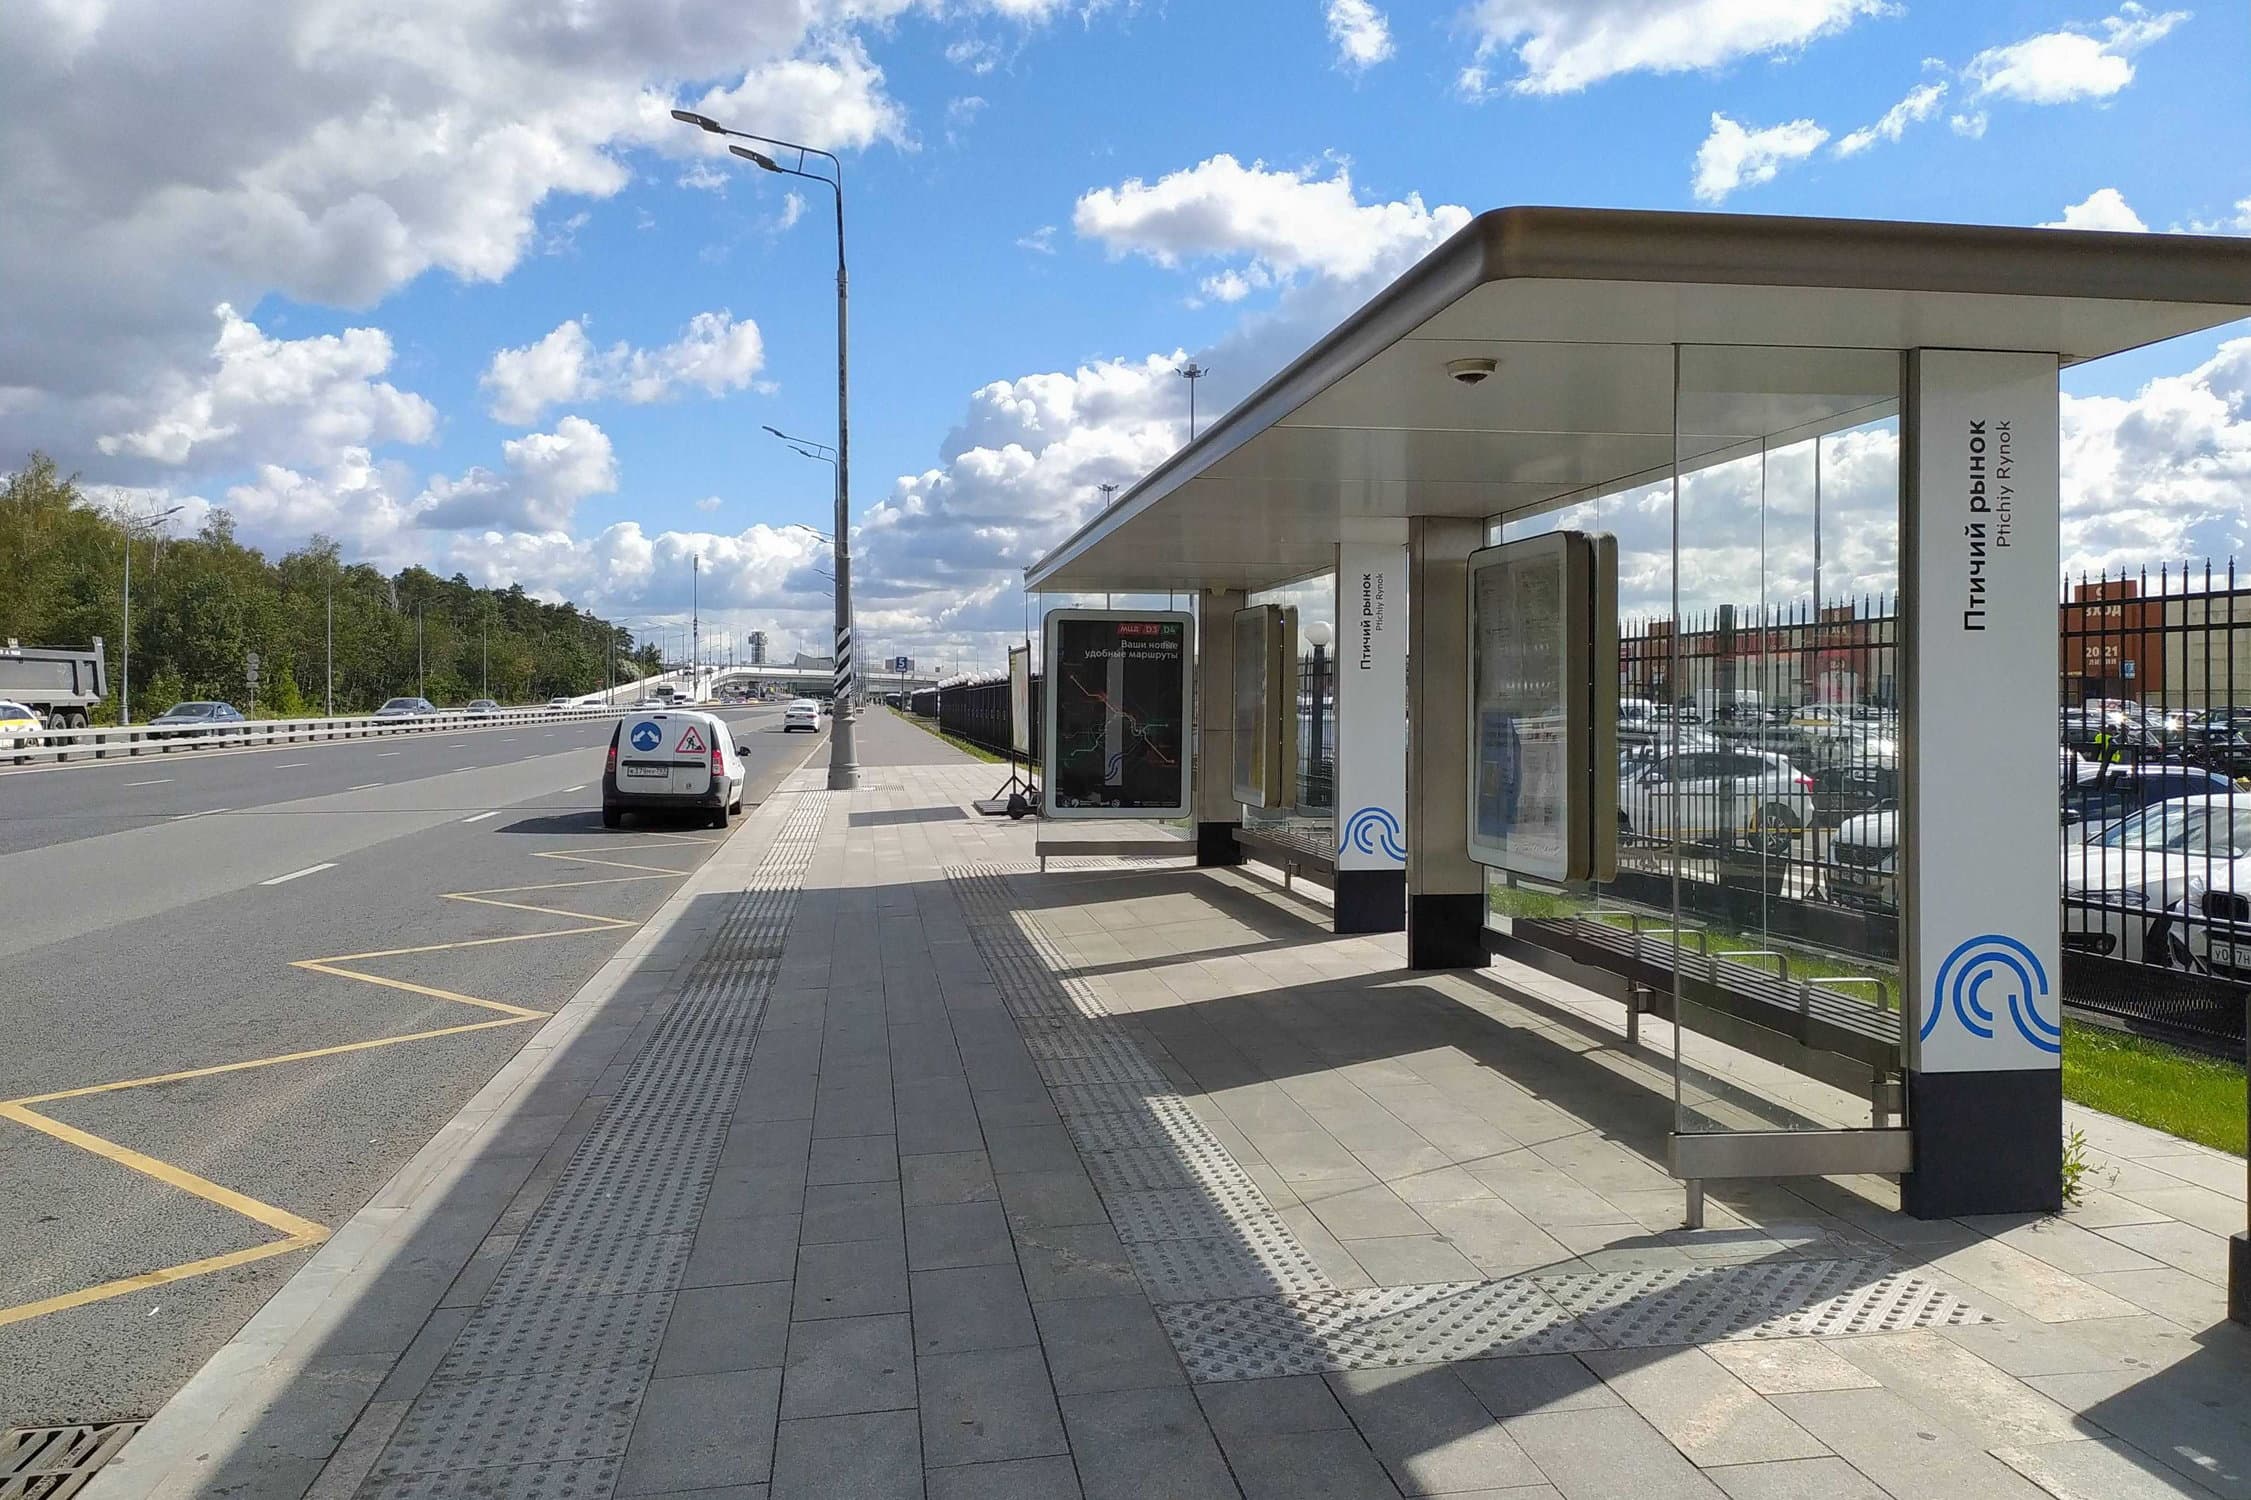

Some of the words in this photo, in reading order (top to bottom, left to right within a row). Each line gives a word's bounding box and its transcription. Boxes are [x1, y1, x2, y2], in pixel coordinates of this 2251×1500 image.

[1969, 419, 1992, 513] рынок
[1995, 420, 2015, 479] Rynok
[1996, 485, 2015, 547] Ptichiy
[1362, 573, 1373, 616] рынок
[1375, 572, 1385, 600] Rynok
[1963, 523, 1986, 631] Птичий
[1375, 601, 1385, 631] Ptichiy
[1084, 649, 1126, 659] удобные
[1128, 651, 1178, 660] маршруты
[1121, 639, 1147, 649] Ваши
[1360, 620, 1371, 669] Птичий
